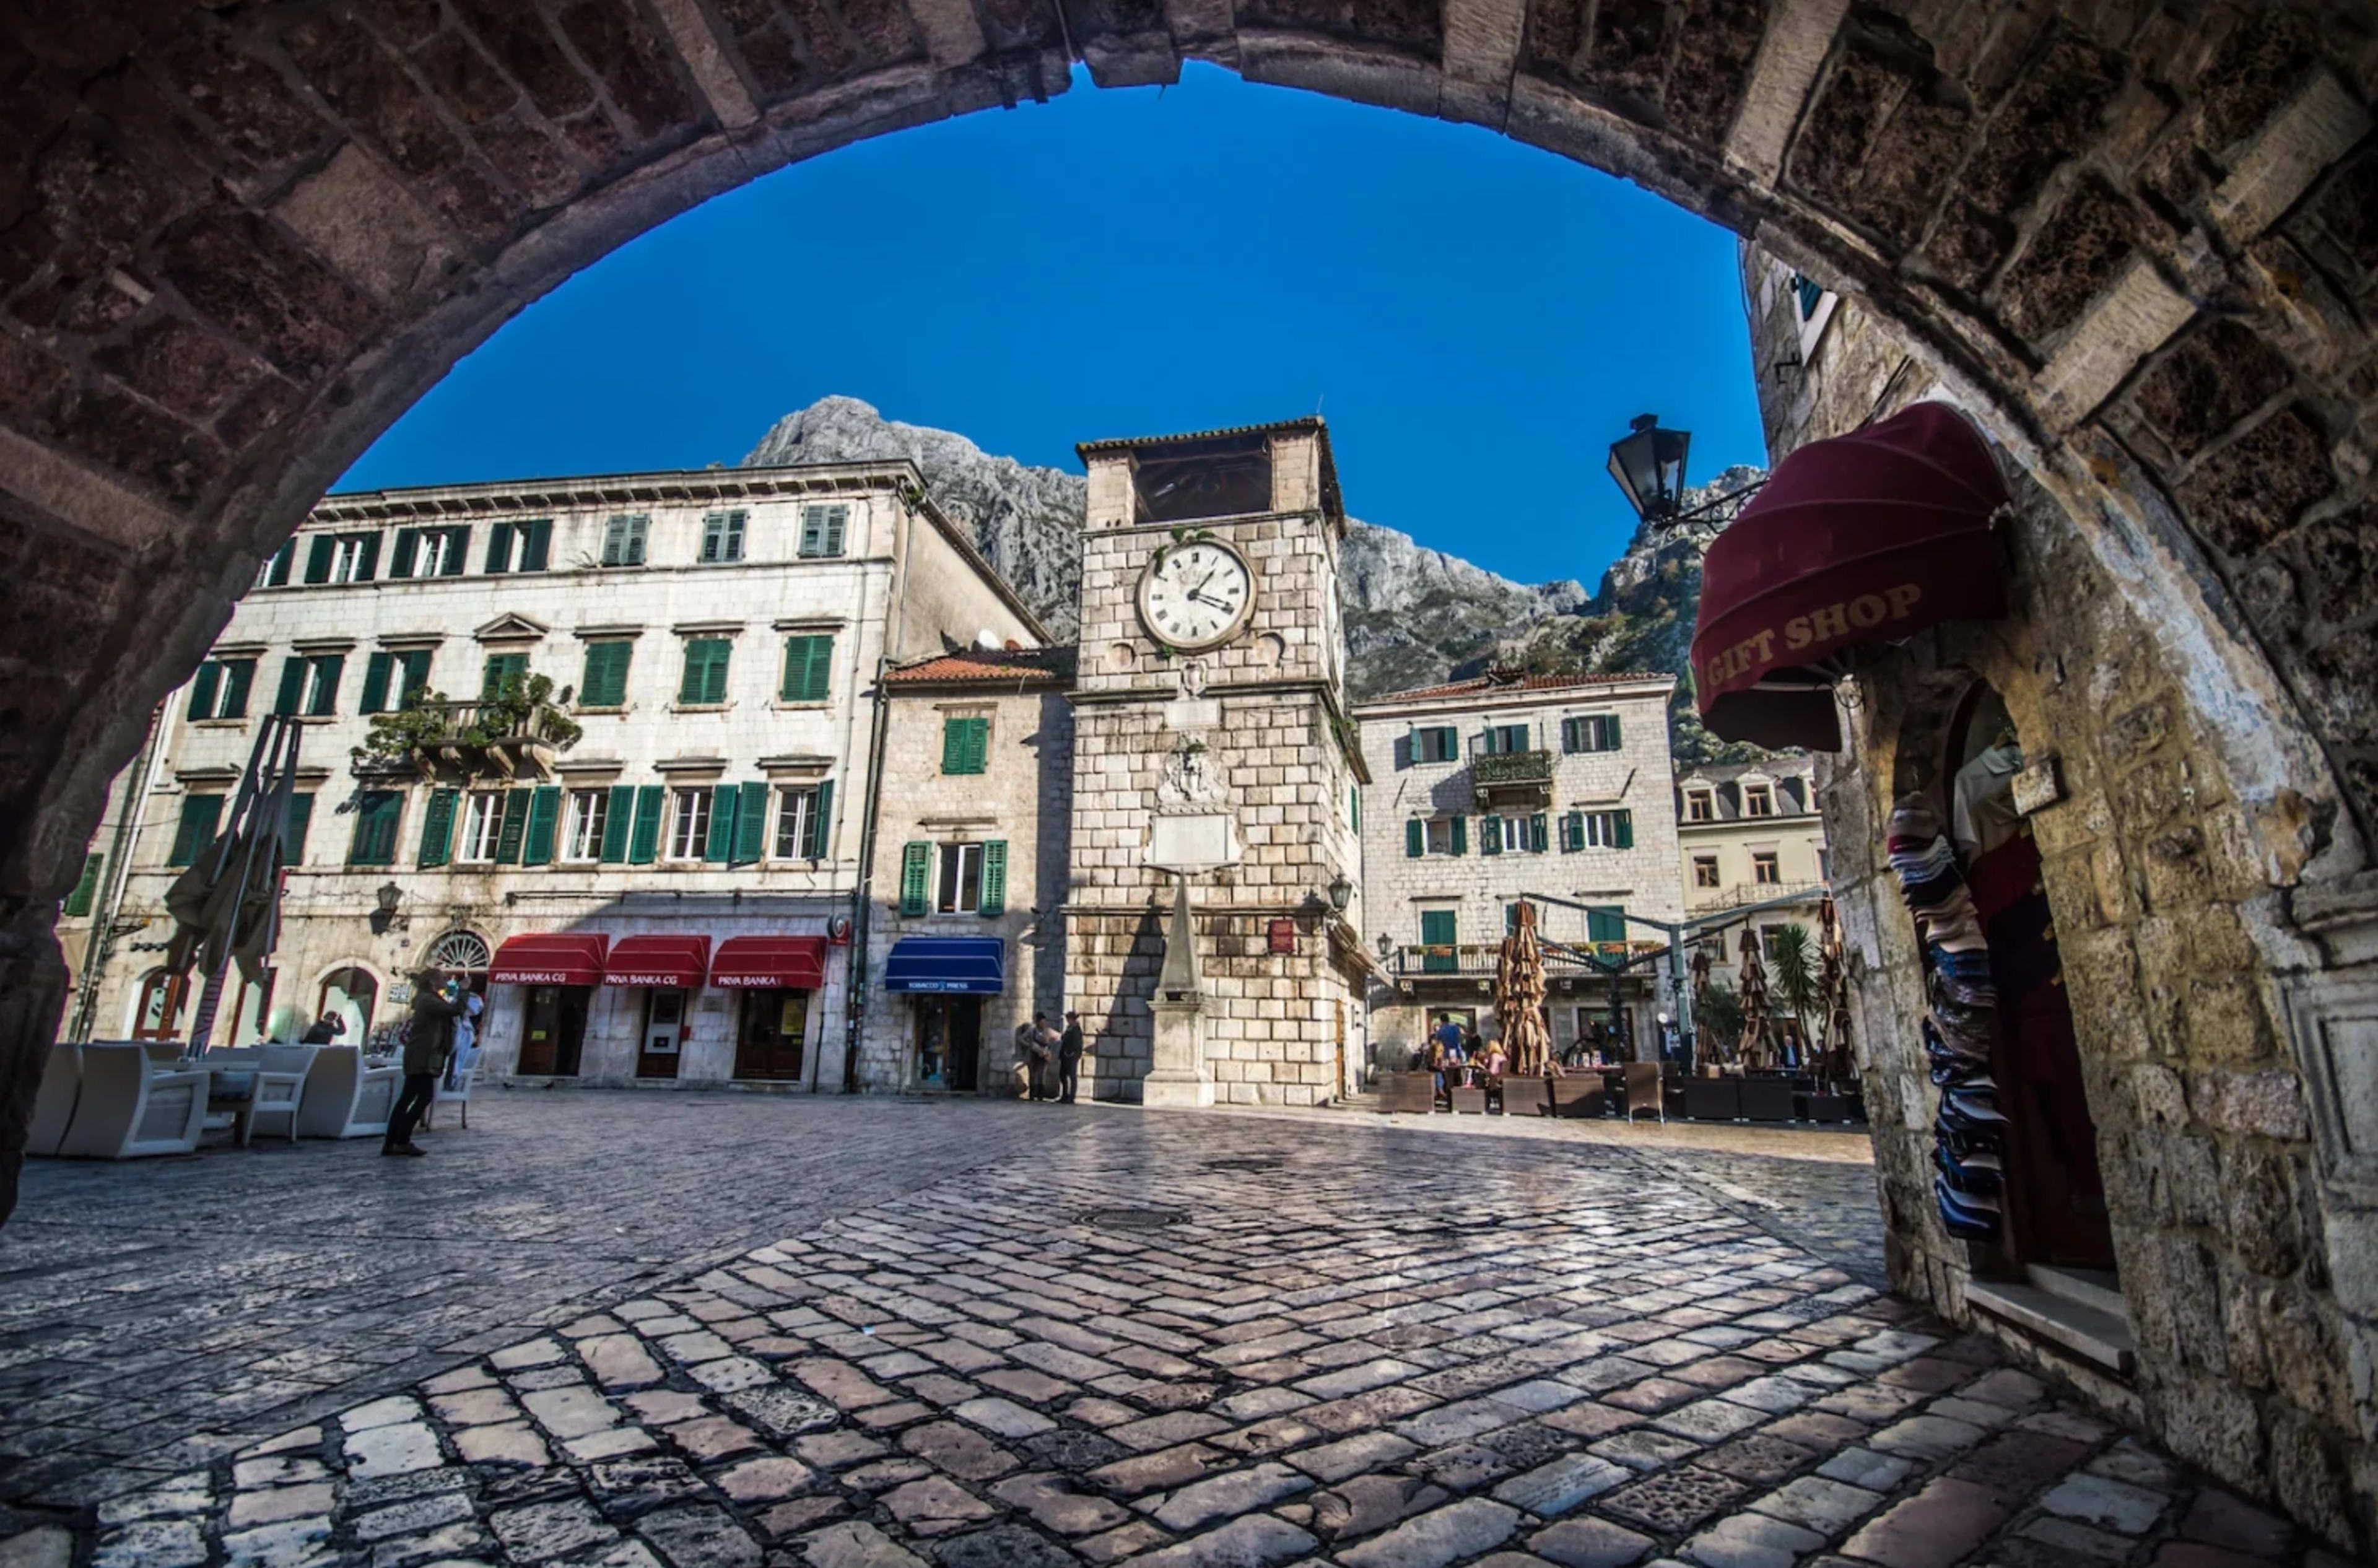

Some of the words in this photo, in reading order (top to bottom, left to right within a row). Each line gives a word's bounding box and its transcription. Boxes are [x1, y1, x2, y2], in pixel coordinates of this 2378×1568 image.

[1709, 629, 1775, 686] GIFT
[1785, 584, 1921, 650] SHOP
[496, 973, 518, 981] PRVA
[520, 973, 550, 982] BANKA
[552, 973, 566, 982] CG
[606, 975, 628, 983] PRVA
[630, 975, 661, 984] BANKA
[663, 976, 677, 985] CG
[718, 976, 741, 985] PRVA
[743, 976, 776, 985] BANKA
